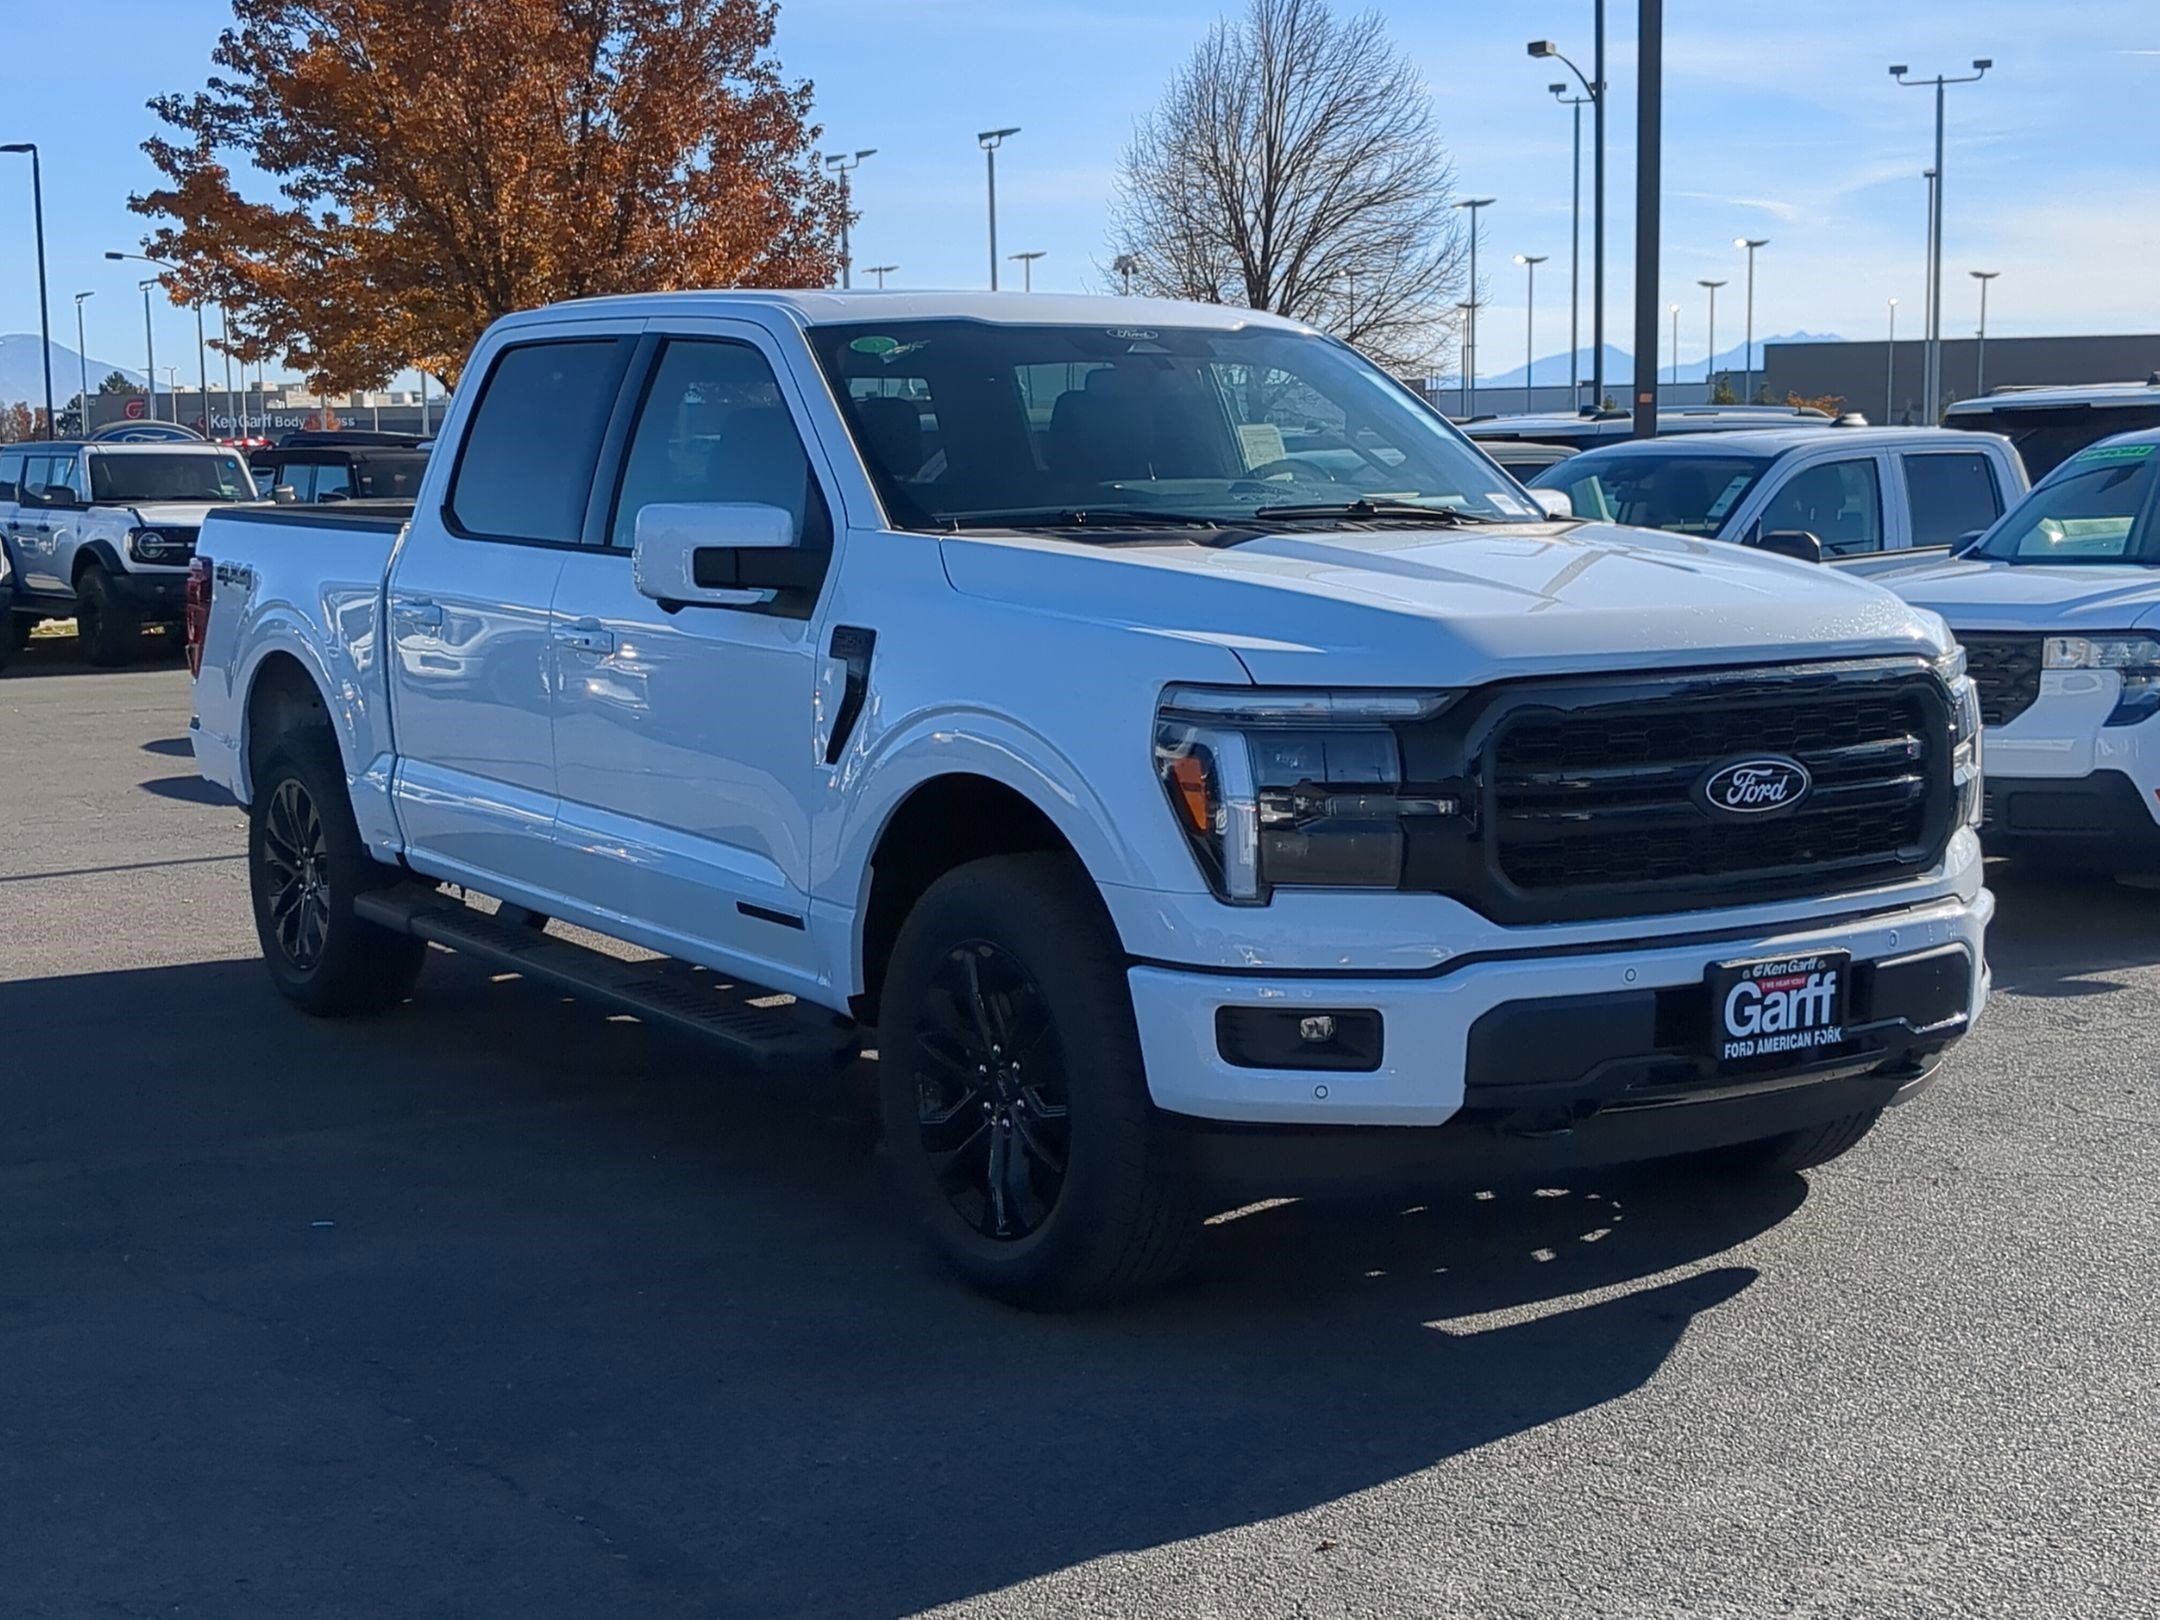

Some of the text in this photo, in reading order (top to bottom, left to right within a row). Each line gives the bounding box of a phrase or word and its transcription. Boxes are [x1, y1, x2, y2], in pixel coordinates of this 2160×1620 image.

[210, 414, 237, 428] Ken
[274, 416, 305, 429] Body
[1726, 768, 1788, 804] Ford
[1763, 962, 1787, 976] Ken
[1787, 957, 1817, 973] Garff
[1724, 970, 1837, 1037] Garff
[1724, 1026, 1842, 1059] FORD AMERICAN FORK
